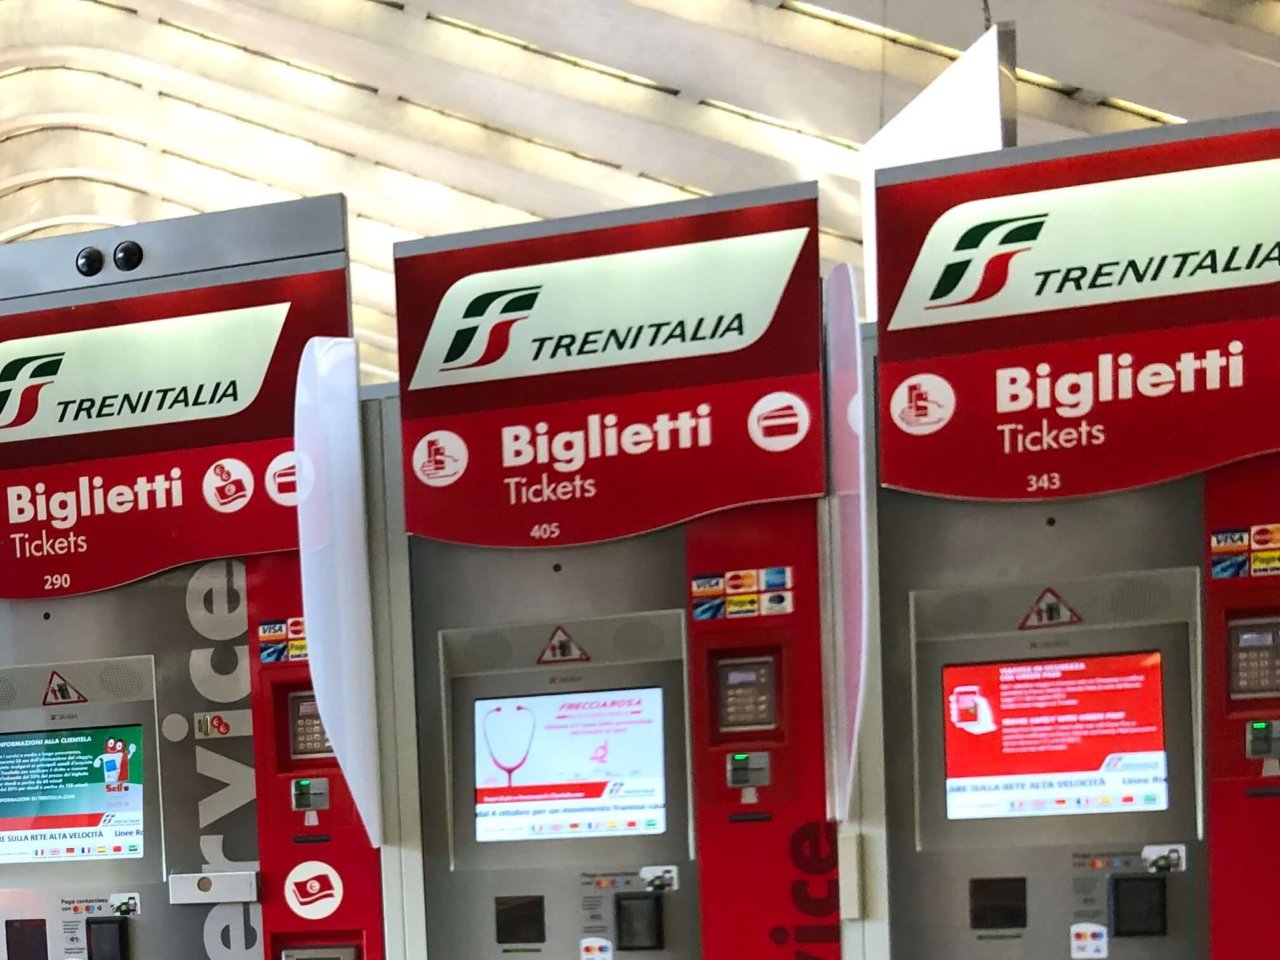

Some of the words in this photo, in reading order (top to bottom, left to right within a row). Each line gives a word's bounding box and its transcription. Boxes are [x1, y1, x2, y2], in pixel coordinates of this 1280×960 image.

[1034, 240, 1280, 296] TRENITALIA
[531, 313, 744, 361] TRENITALIA
[995, 339, 1244, 418] Biglietti
[56, 380, 239, 422] TRENITALIA
[501, 403, 712, 473] Biglietti
[997, 418, 1105, 454] Tickets
[503, 473, 597, 506] Tickets
[1026, 472, 1061, 491] 343
[6, 467, 183, 529] Biglietti
[9, 530, 87, 560] Tickets
[530, 522, 560, 540] 405
[1215, 533, 1244, 545] VISA
[43, 573, 71, 590] 290
[261, 625, 284, 634] VISA
[60, 736, 92, 744] CLIENTELA
[7, 834, 30, 842] SULLA
[48, 832, 68, 840] ALTA
[69, 830, 104, 839] VELOCITÀ
[114, 829, 134, 837] Linee
